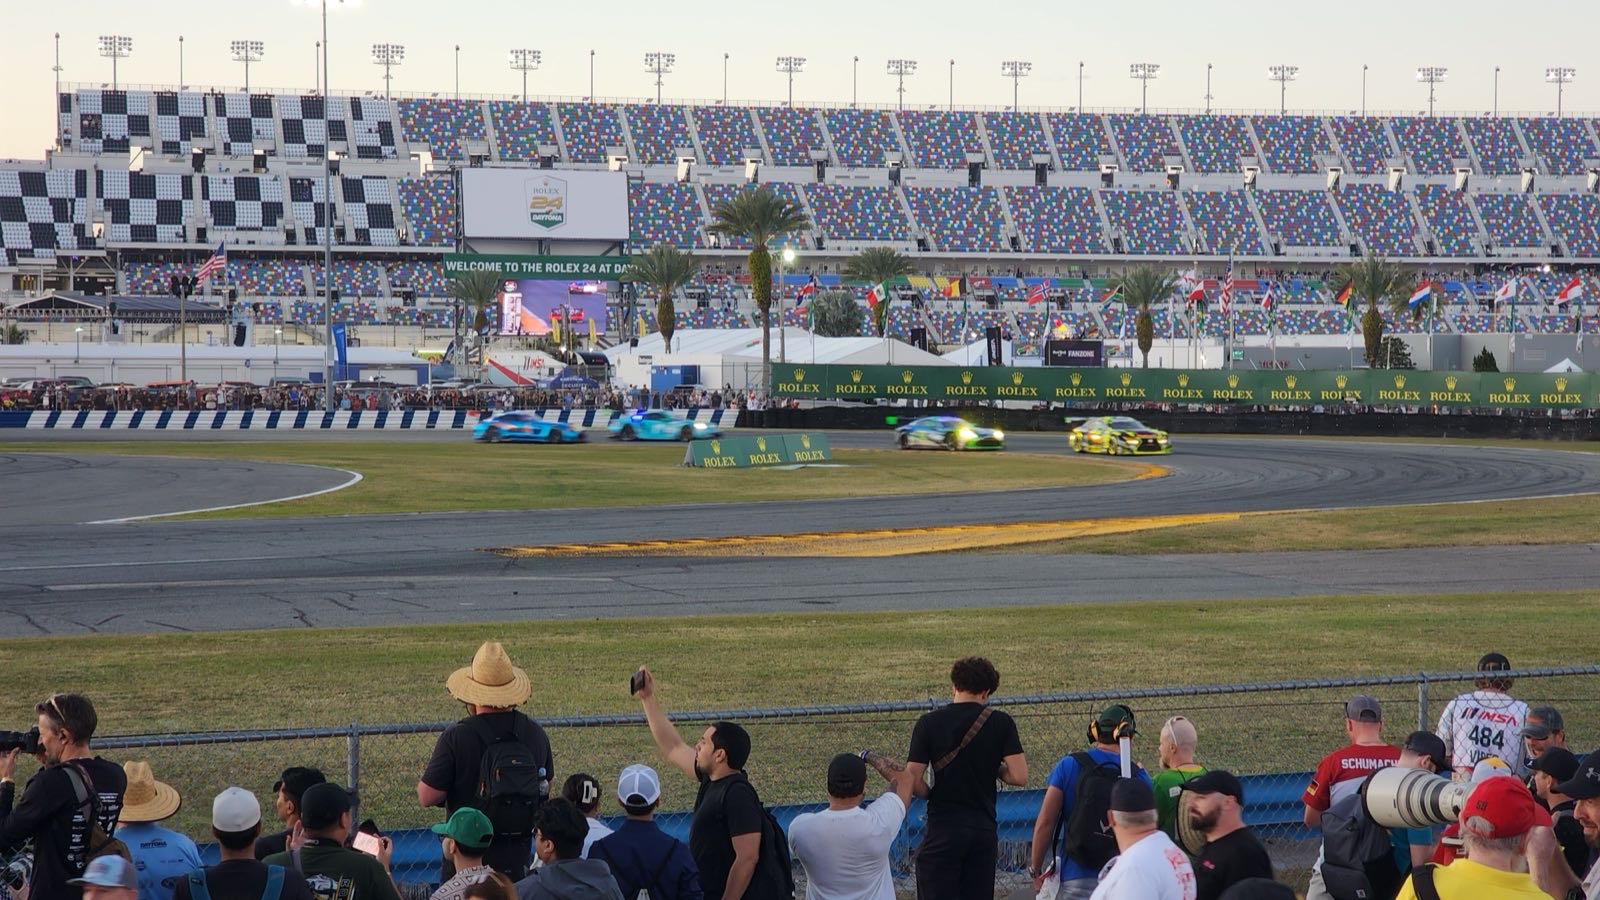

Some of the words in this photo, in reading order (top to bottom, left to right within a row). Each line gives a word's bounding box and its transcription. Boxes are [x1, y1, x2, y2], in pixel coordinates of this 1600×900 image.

[530, 196, 563, 209] 24
[532, 213, 563, 221] DAYTONA
[446, 261, 502, 272] WELCOME
[504, 262, 519, 272] TO
[521, 262, 542, 273] THE
[545, 263, 580, 273] ROLEX
[582, 263, 596, 273] 24
[599, 263, 612, 274] AT
[778, 383, 820, 393] ROLEX
[836, 384, 877, 394] ROLEX
[886, 384, 929, 395] ROLEX
[946, 385, 988, 396] ROLEX
[997, 386, 1038, 397] ROLEX
[1056, 388, 1096, 397] ROLEX
[1106, 388, 1146, 398] ROLEX
[1163, 389, 1203, 398] ROLEX
[1213, 390, 1253, 399] ROLEX
[1271, 390, 1311, 400] ROLEX
[1321, 390, 1361, 400] ROLEX
[1379, 391, 1420, 401] ROLEX
[1430, 392, 1471, 402] ROLEX
[1489, 393, 1531, 404] ROLEX
[1540, 394, 1582, 404] ROLEX
[703, 456, 736, 467] ROLEX
[749, 453, 781, 464] ROLEX
[795, 450, 825, 462] ROLEX
[1478, 711, 1517, 727] IMSA
[1468, 725, 1505, 750] 484
[1469, 750, 1499, 763] VID
[1341, 758, 1399, 770] SCHUMACH
